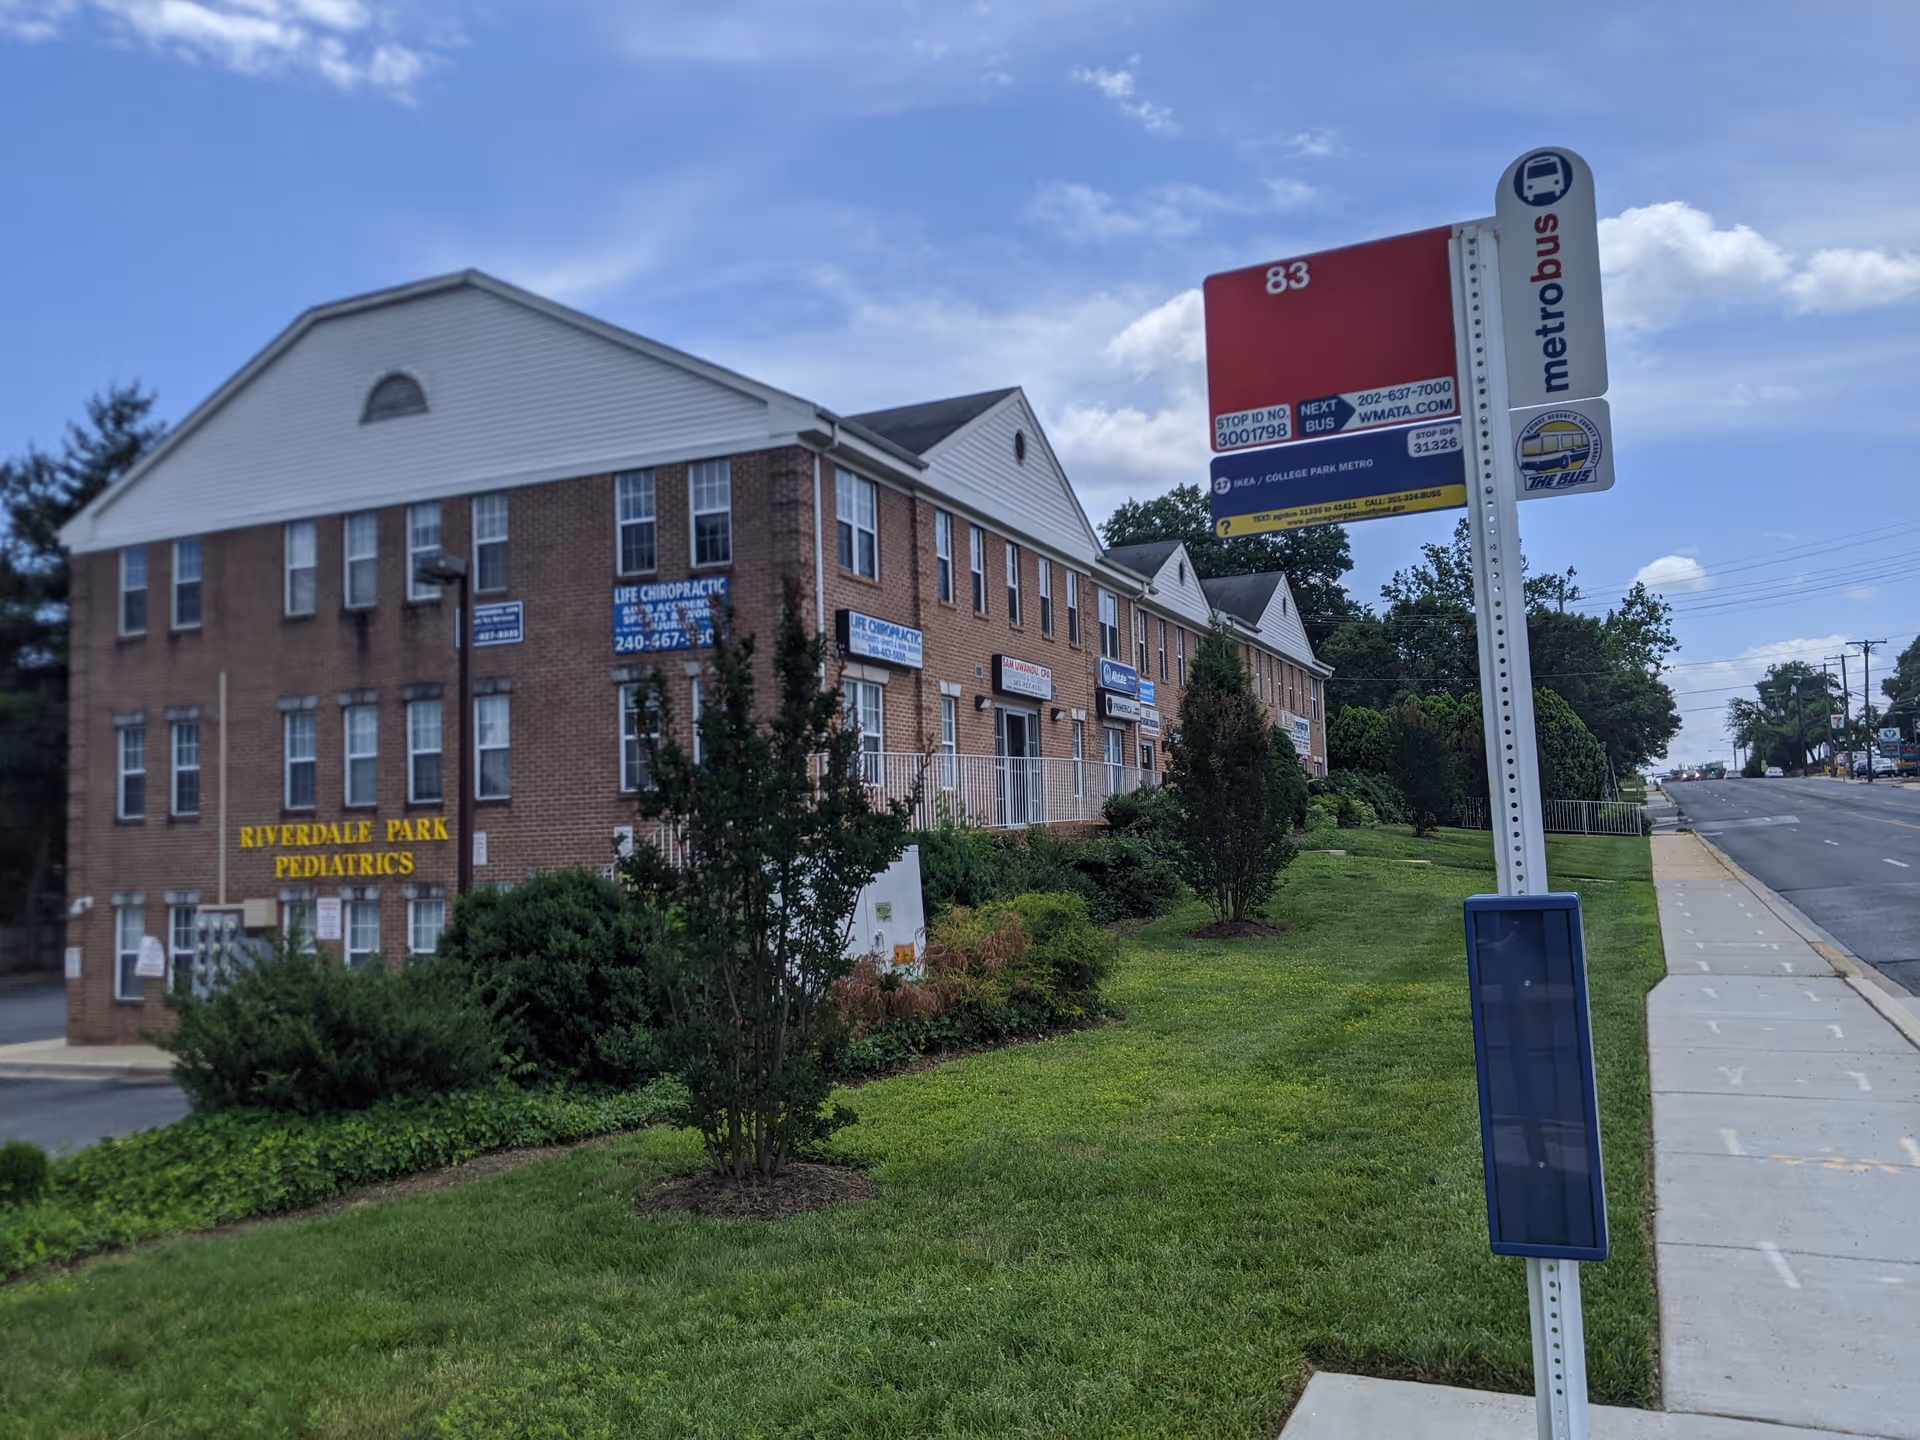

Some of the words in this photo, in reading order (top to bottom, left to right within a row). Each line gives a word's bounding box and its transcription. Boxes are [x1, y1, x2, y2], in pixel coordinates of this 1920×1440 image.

[1265, 261, 1310, 294] 83
[1530, 212, 1570, 394] metrobus
[1357, 380, 1451, 407] 202-637-7000
[1216, 414, 1249, 430] STOP
[1252, 411, 1264, 424] ID
[1267, 407, 1290, 420] NO.
[1300, 399, 1337, 417] NEXT
[1358, 398, 1453, 424] WMATA.COM
[1217, 422, 1288, 447] 3001798
[1305, 417, 1335, 432] BUS
[1415, 430, 1438, 440] STOP
[1414, 437, 1458, 453] 31326
[1233, 476, 1256, 488] IKEA
[1265, 468, 1308, 483] COLLEGE
[1310, 464, 1337, 477] PARK
[1338, 458, 1374, 473] METRO
[1528, 473, 1558, 489] THE
[1556, 468, 1593, 485] BUS
[614, 586, 639, 605] LIFE
[639, 577, 727, 601] CHIROPRACTIC
[850, 614, 867, 631] LIFE
[868, 619, 921, 647] CHIROPRACTIC
[1002, 657, 1014, 669] SAM
[1040, 668, 1051, 680] CPA
[239, 820, 373, 849] RIVERDALE
[385, 816, 450, 843] PARK
[273, 851, 415, 879] PEDIATRICS
